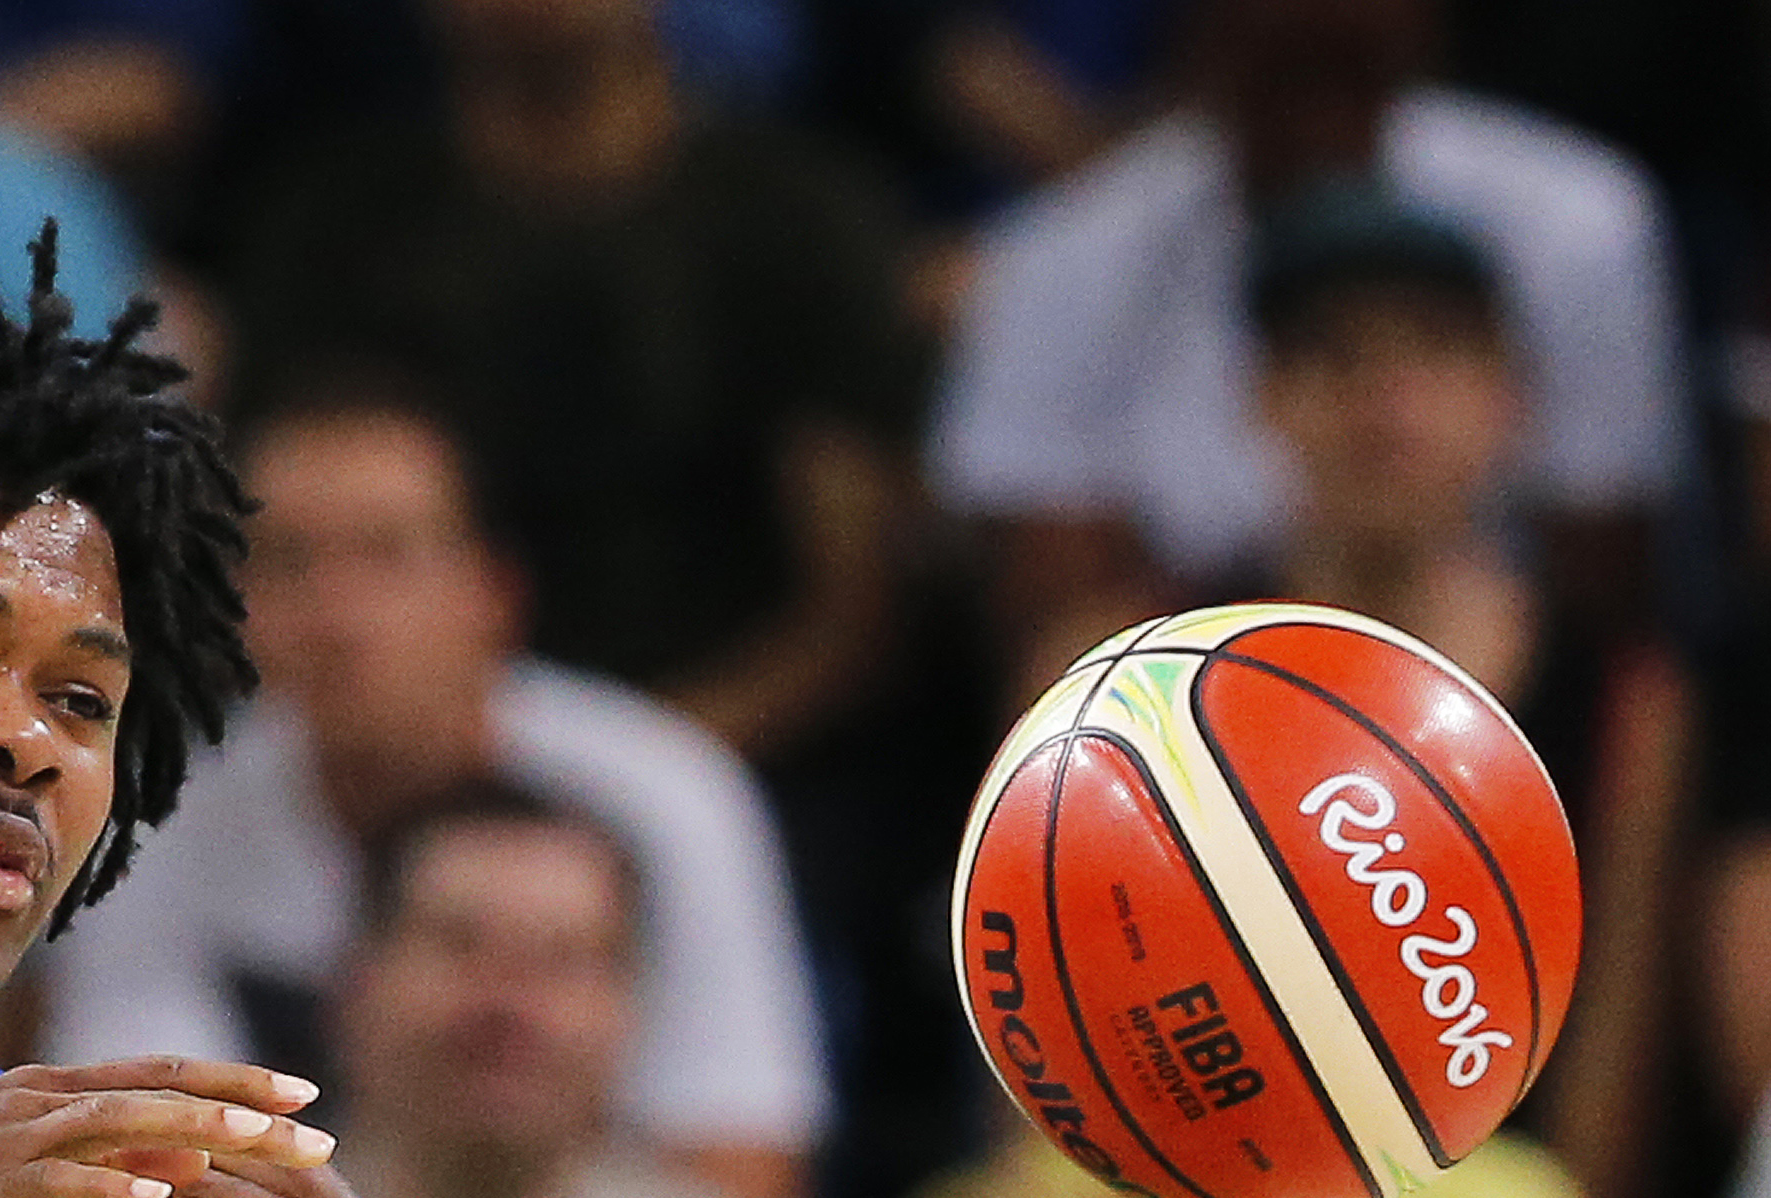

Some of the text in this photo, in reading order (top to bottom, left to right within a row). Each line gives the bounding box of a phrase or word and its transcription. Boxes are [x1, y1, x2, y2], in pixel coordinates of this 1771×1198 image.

[1298, 772, 1513, 1089] Rio 2016
[1128, 1005, 1207, 1122] APPROVED
[1156, 981, 1266, 1109] FIBA
